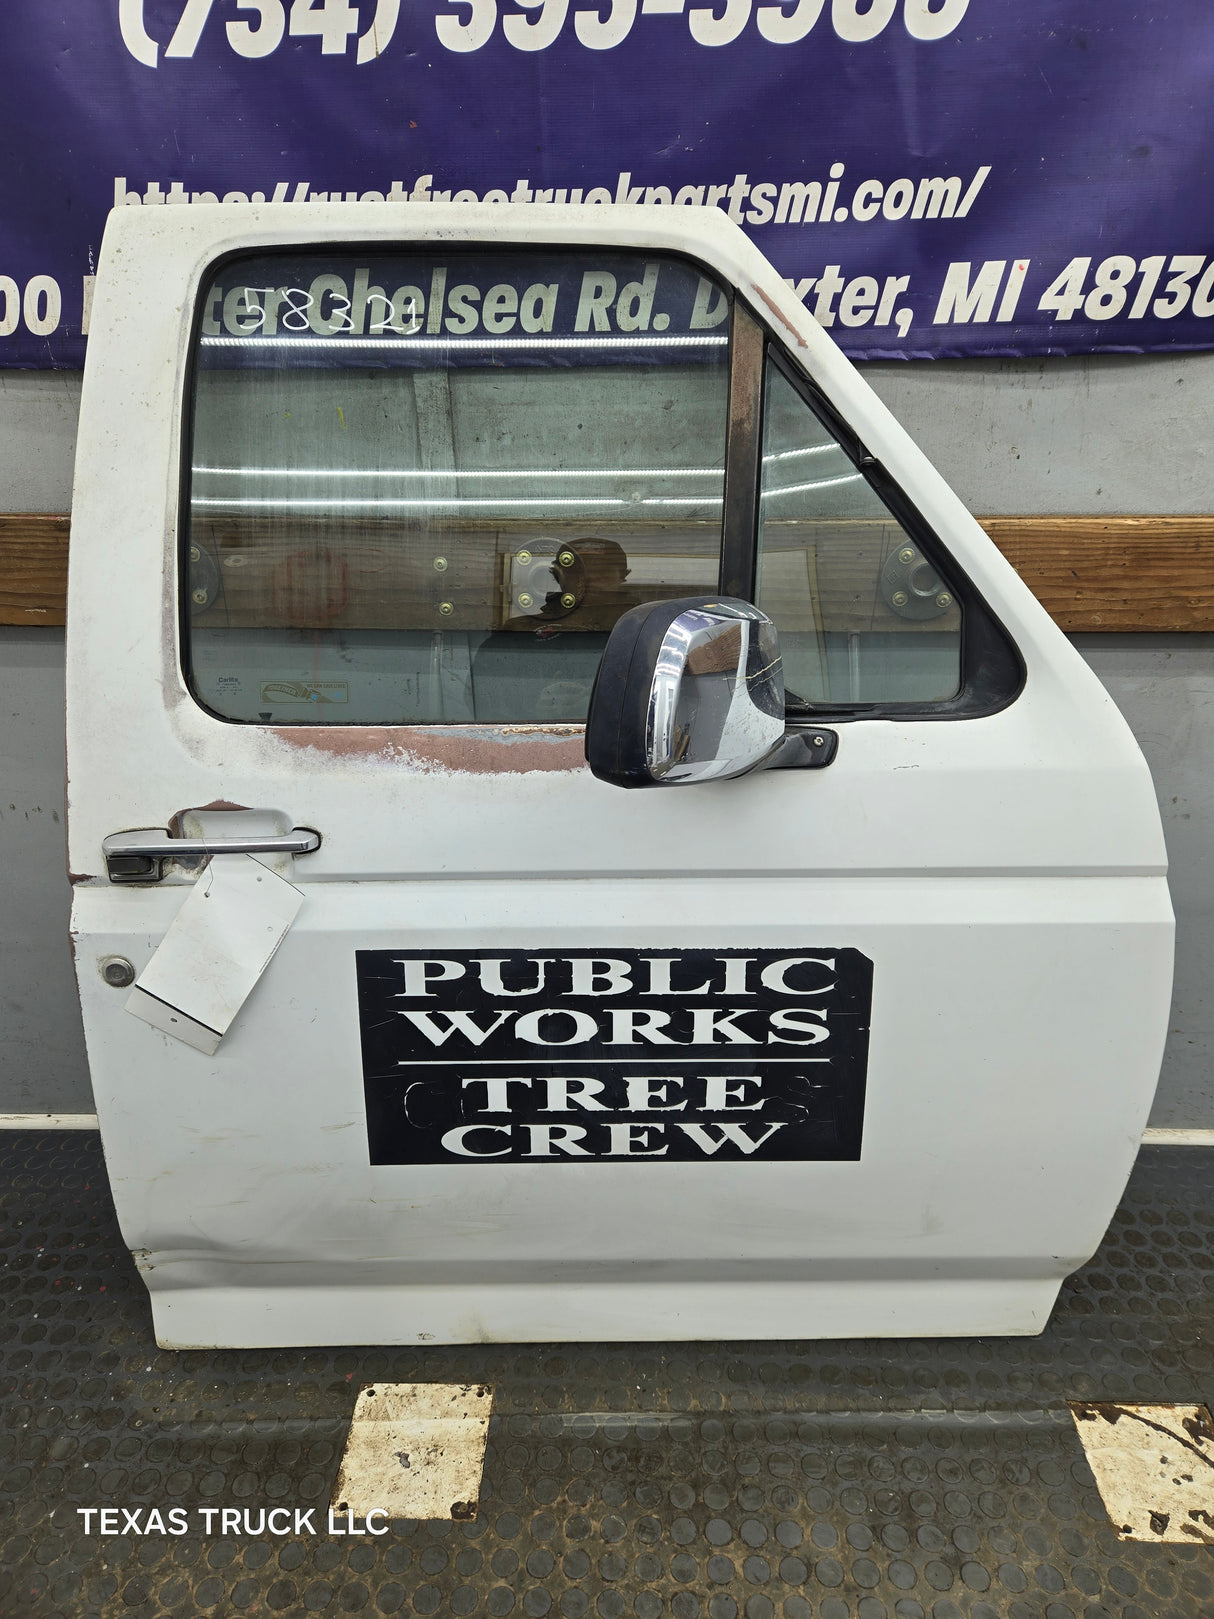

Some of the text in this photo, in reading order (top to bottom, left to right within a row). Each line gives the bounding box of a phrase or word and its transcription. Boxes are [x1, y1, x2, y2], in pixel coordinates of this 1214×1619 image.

[240, 287, 421, 335] 58321
[307, 266, 556, 336] Chelsea
[574, 263, 671, 332] Rd.
[933, 259, 1031, 325] MI
[393, 957, 838, 996] PUBLIC
[397, 1008, 830, 1046] WORKS
[461, 1075, 769, 1113] TREE
[440, 1122, 791, 1157] CREW
